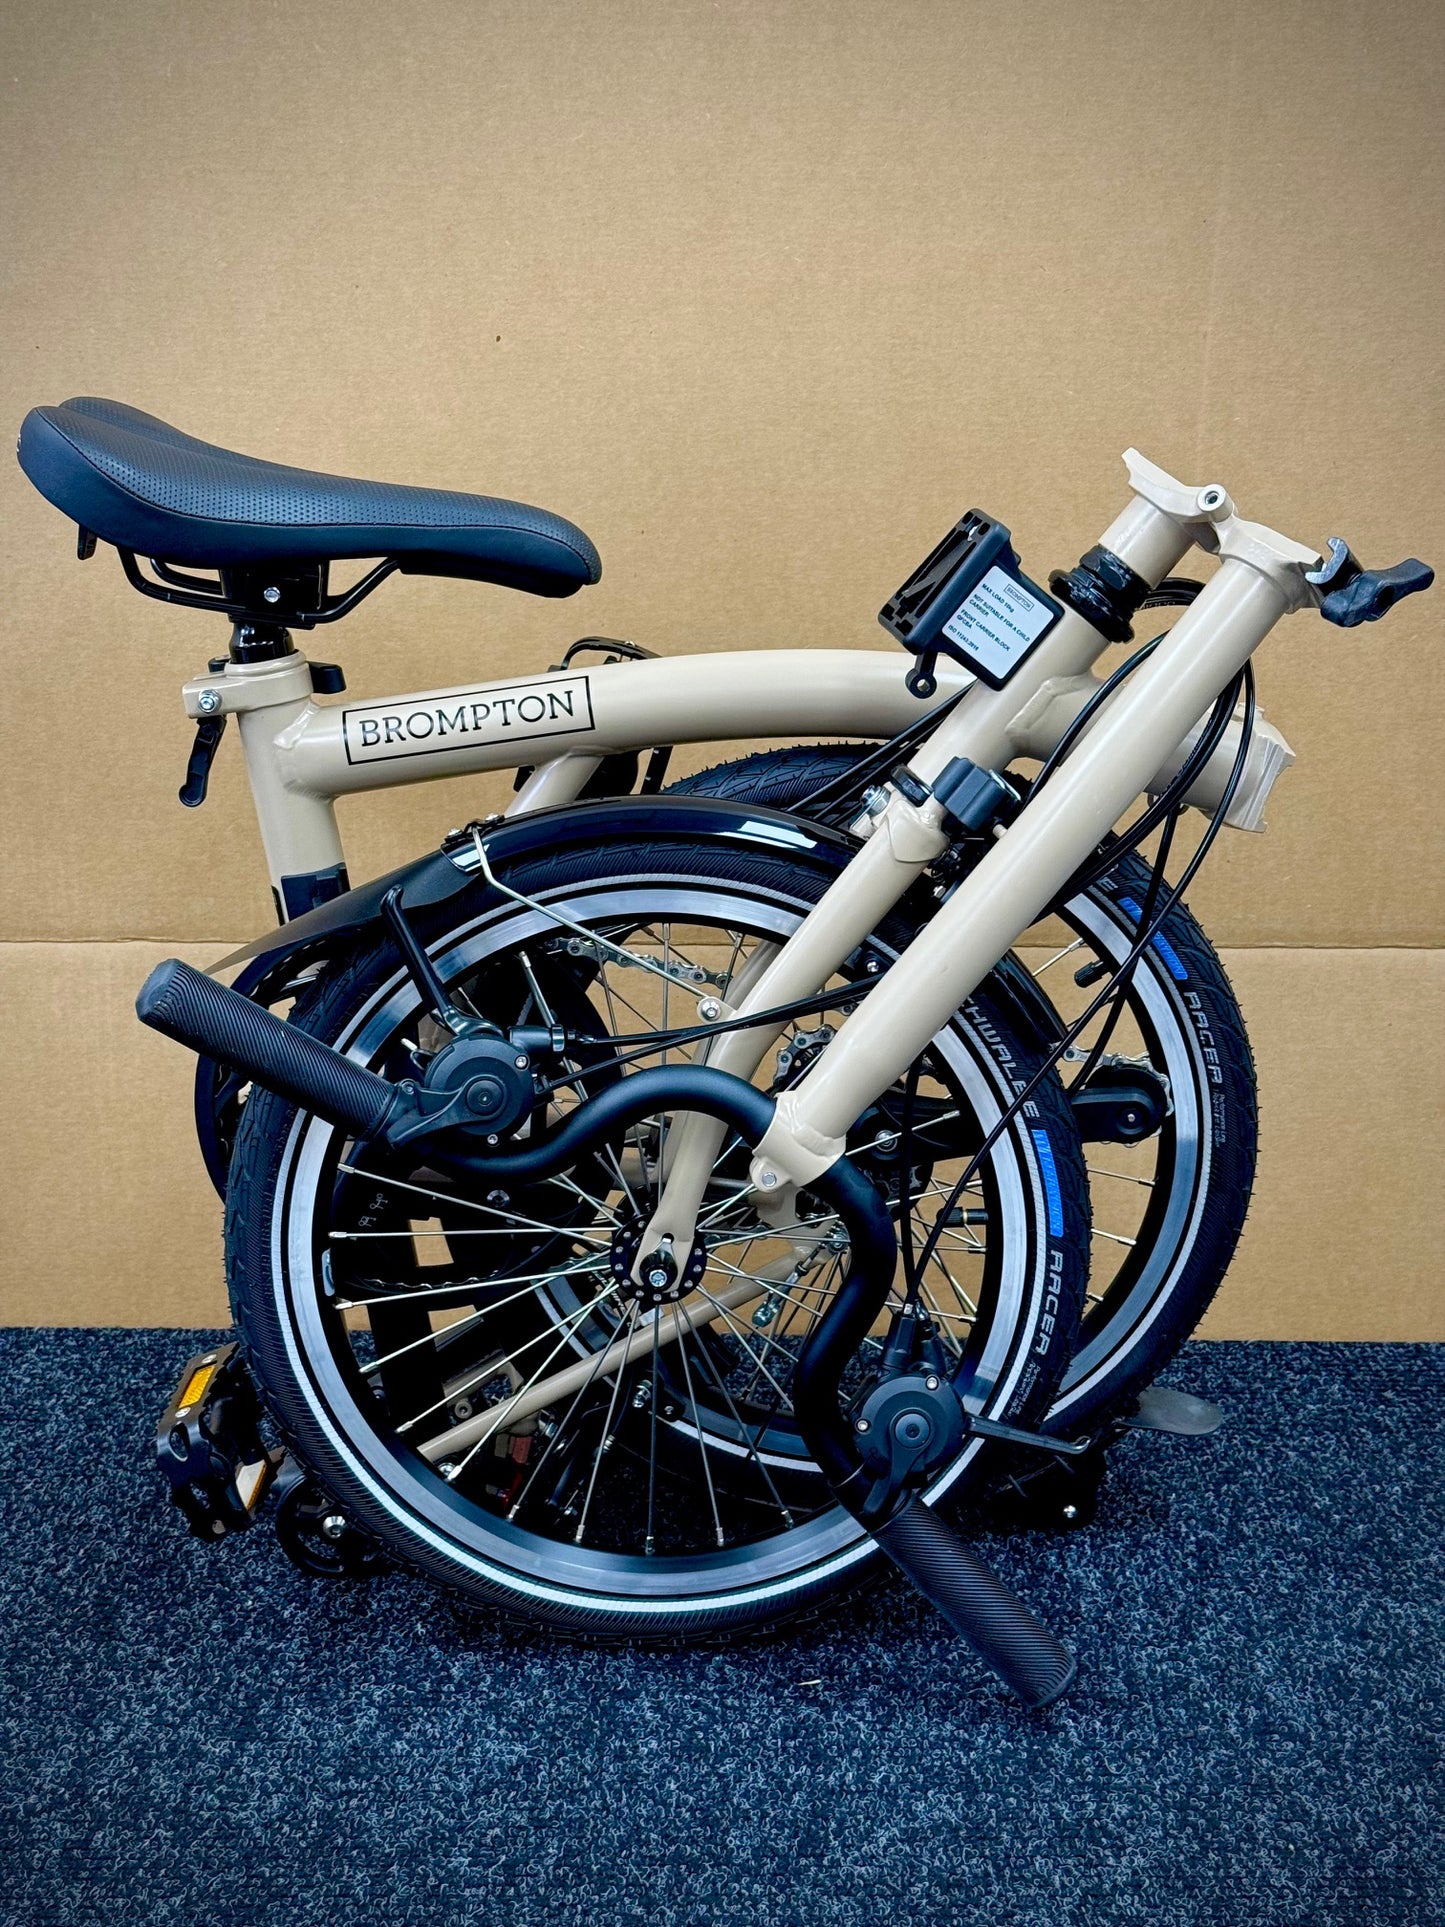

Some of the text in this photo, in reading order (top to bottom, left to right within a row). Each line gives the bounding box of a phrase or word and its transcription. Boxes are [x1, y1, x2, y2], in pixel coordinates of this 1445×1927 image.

[969, 599, 990, 617] CARRIER
[981, 583, 992, 593] MAX
[990, 592, 1004, 604] LOAD
[1006, 586, 1032, 609] BROMPTON
[947, 624, 957, 633] ISO
[960, 609, 1011, 652] FRONT CARRIER BLOCK
[973, 594, 984, 603] NOT
[982, 601, 1004, 620] SUITABLE
[1003, 618, 1013, 628] FOR
[1015, 628, 1031, 643] CHILD
[358, 690, 575, 747] BROMPTON
[1184, 991, 1223, 1084] RACER
[1034, 1250, 1063, 1356] RACER
